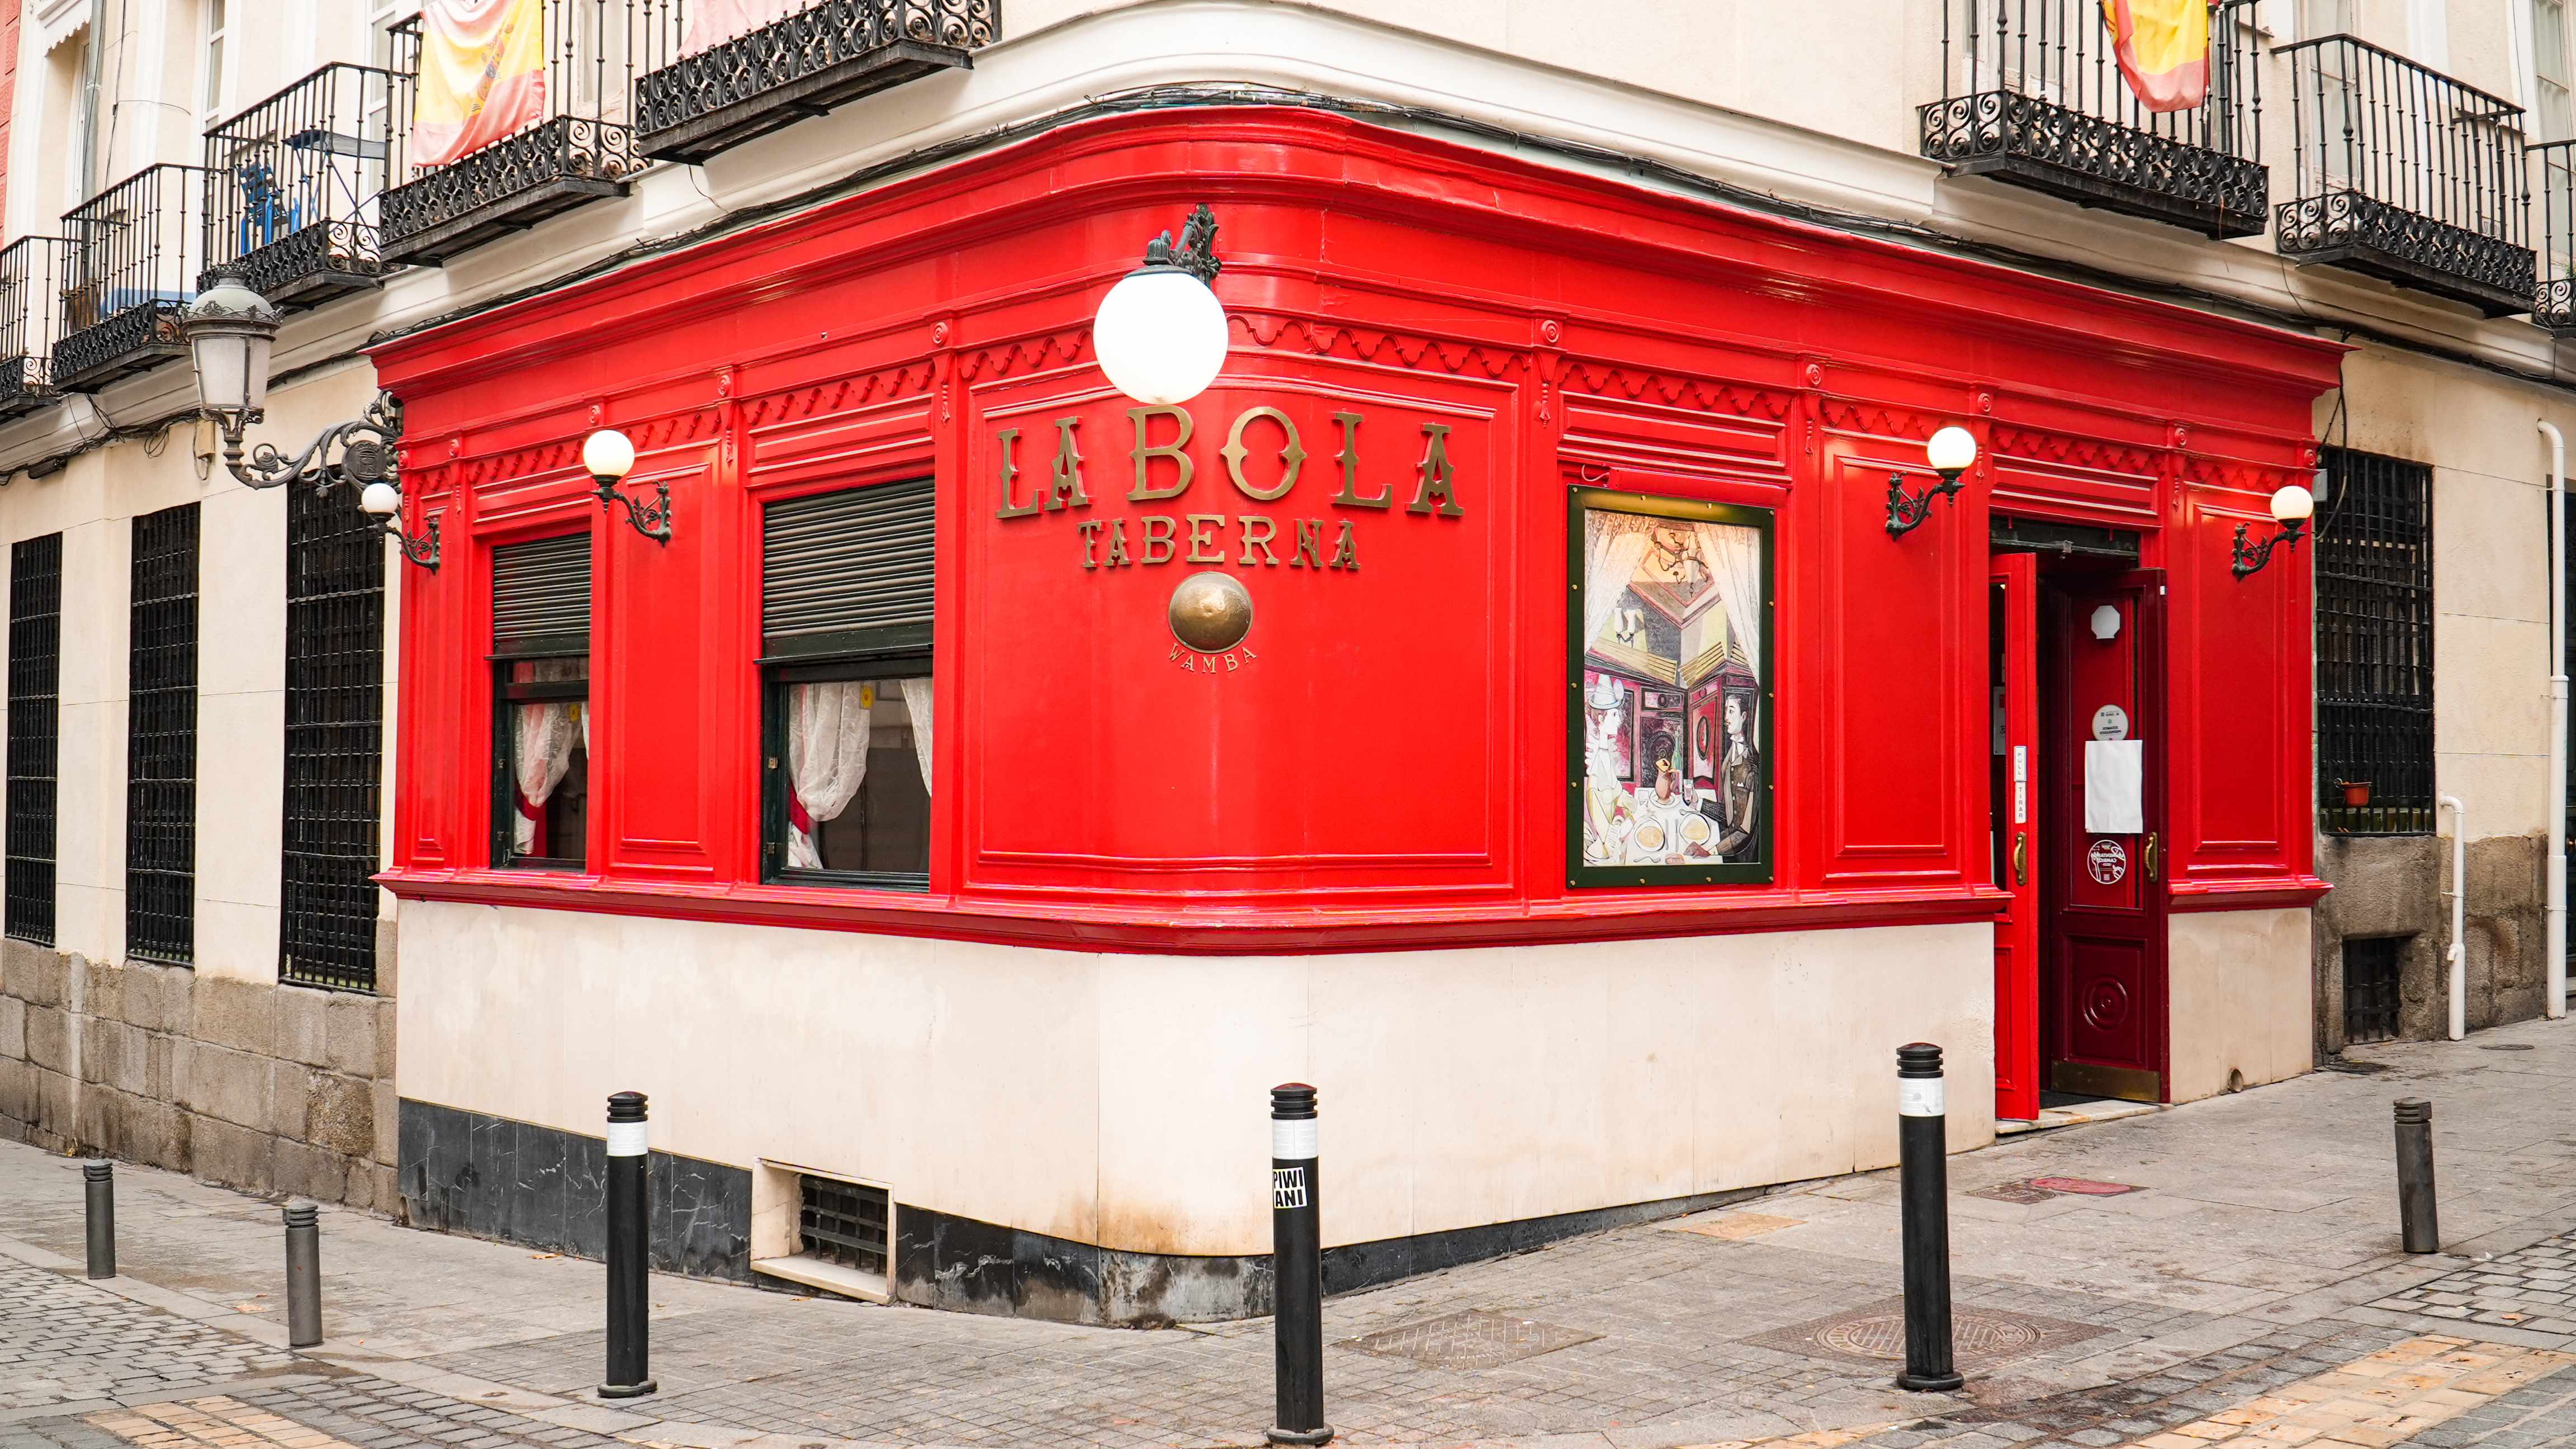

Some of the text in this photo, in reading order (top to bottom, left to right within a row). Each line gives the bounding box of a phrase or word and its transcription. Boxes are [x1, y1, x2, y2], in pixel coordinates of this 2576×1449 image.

[996, 405, 1465, 519] LA BOLA
[1077, 514, 1361, 569] TABERNA
[1168, 643, 1257, 674] WAMBA
